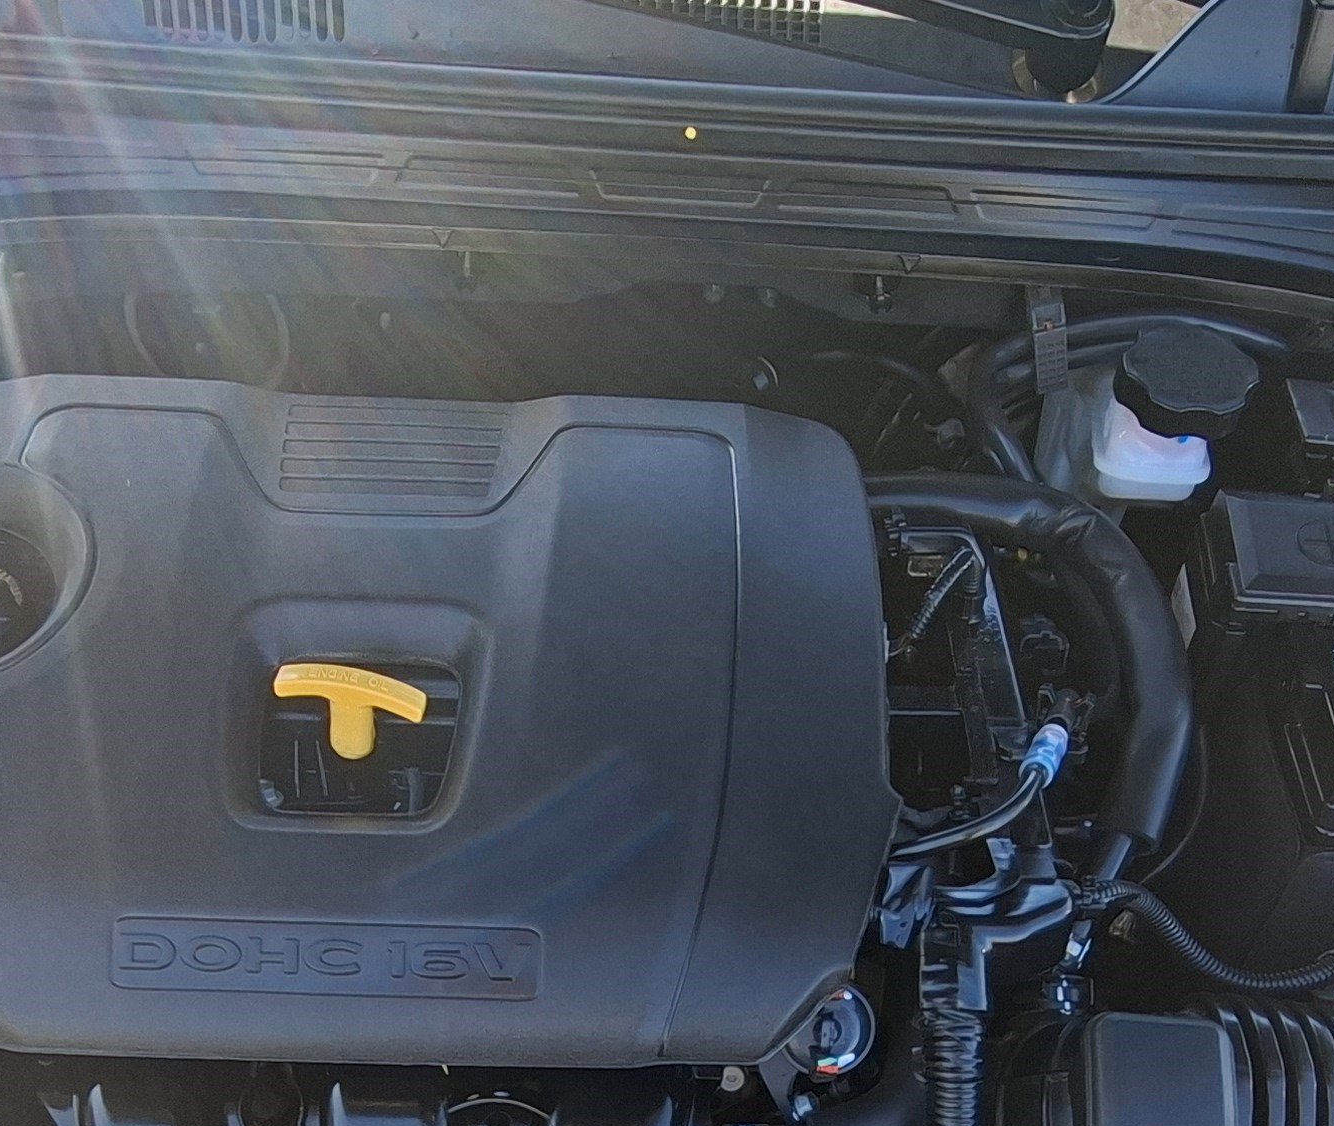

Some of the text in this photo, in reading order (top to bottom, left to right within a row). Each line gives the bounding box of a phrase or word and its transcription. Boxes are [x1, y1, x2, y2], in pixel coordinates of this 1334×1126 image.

[307, 666, 389, 691] ENGINE OIL
[118, 932, 532, 982] DOHC 16V
